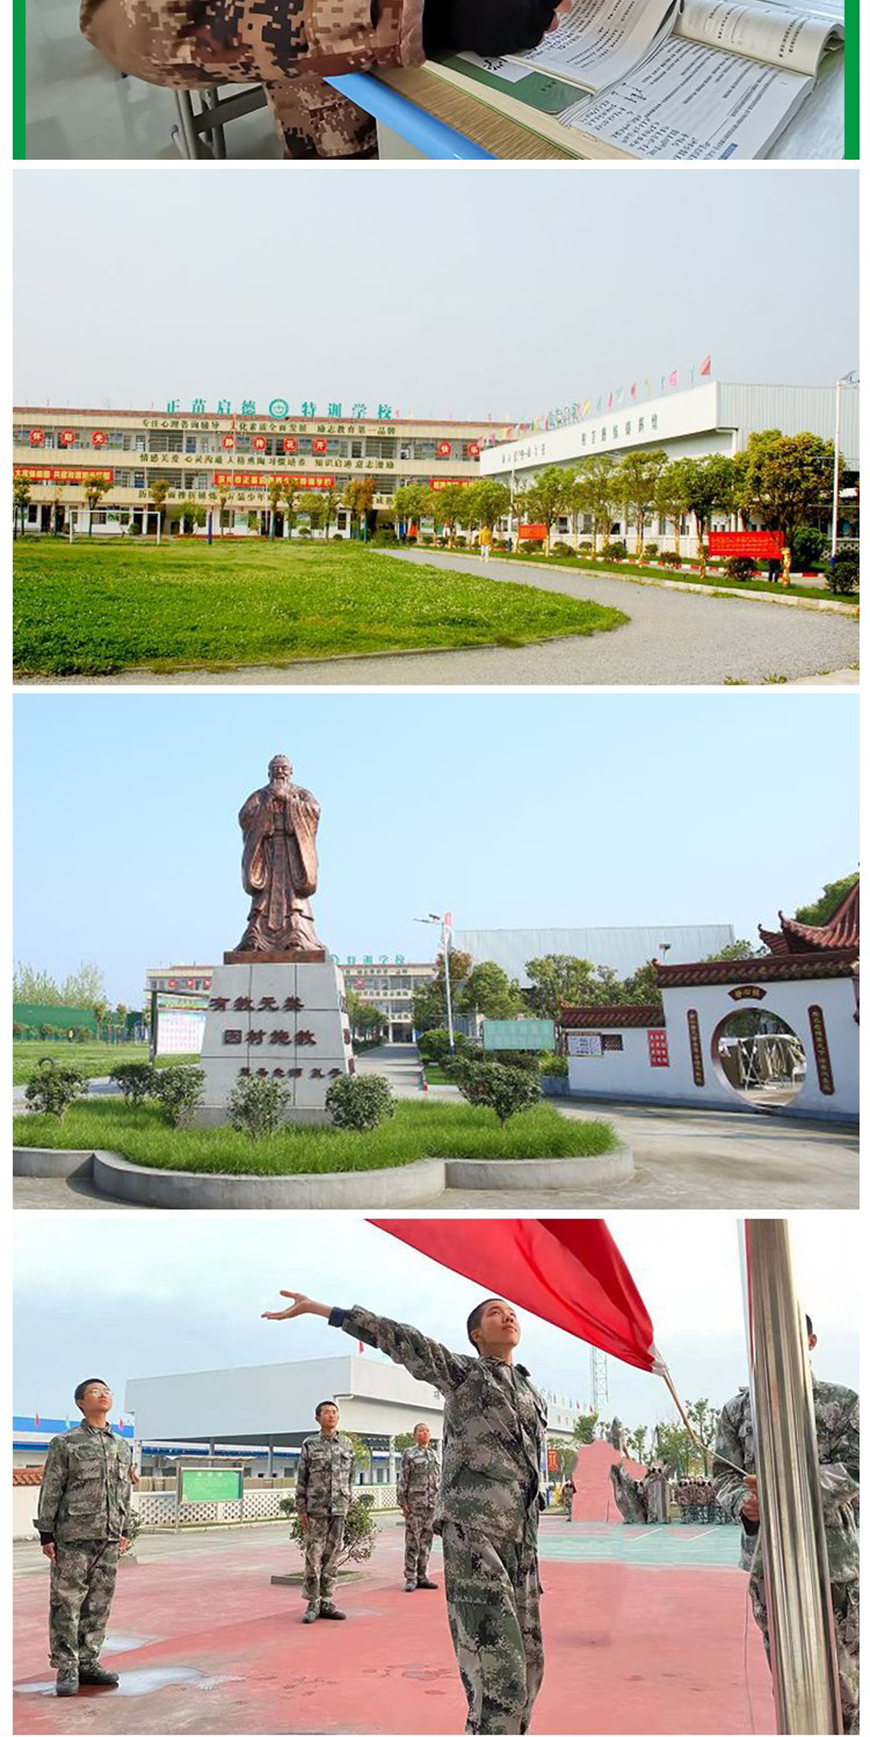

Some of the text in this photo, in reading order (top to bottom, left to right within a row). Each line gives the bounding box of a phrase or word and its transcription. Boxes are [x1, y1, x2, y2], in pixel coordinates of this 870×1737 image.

[301, 401, 392, 419] 特训学校
[223, 1029, 317, 1046] 因材施教
